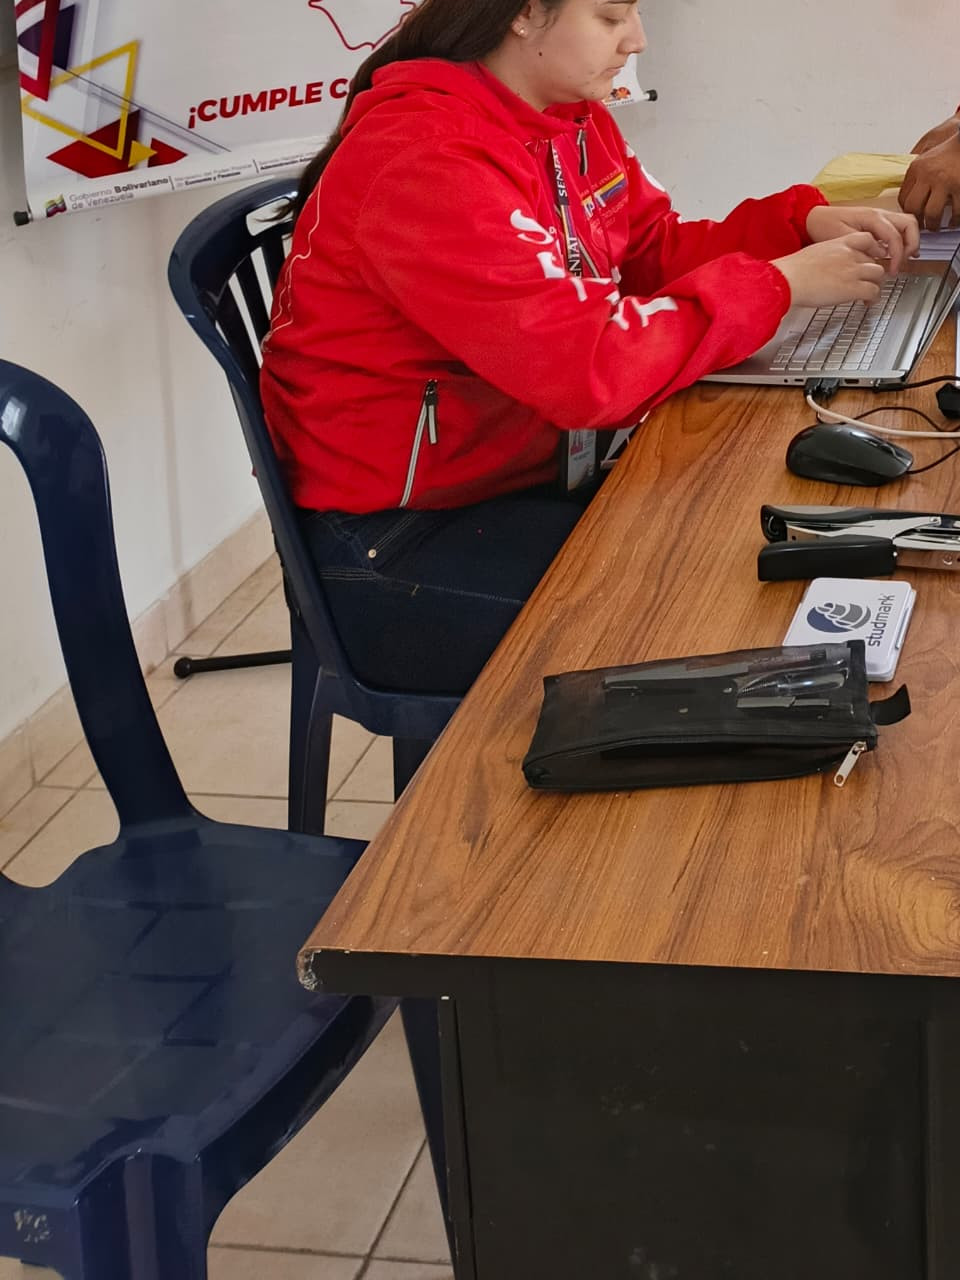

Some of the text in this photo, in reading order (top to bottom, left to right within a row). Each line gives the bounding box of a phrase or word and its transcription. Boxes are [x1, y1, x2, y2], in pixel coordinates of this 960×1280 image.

[187, 81, 323, 129] ¡CUMPLE
[69, 178, 169, 201] Gobierno Bolivariano
[71, 192, 135, 210] de Venezuela
[567, 236, 583, 279] ENIAT
[866, 594, 895, 648] studmark
